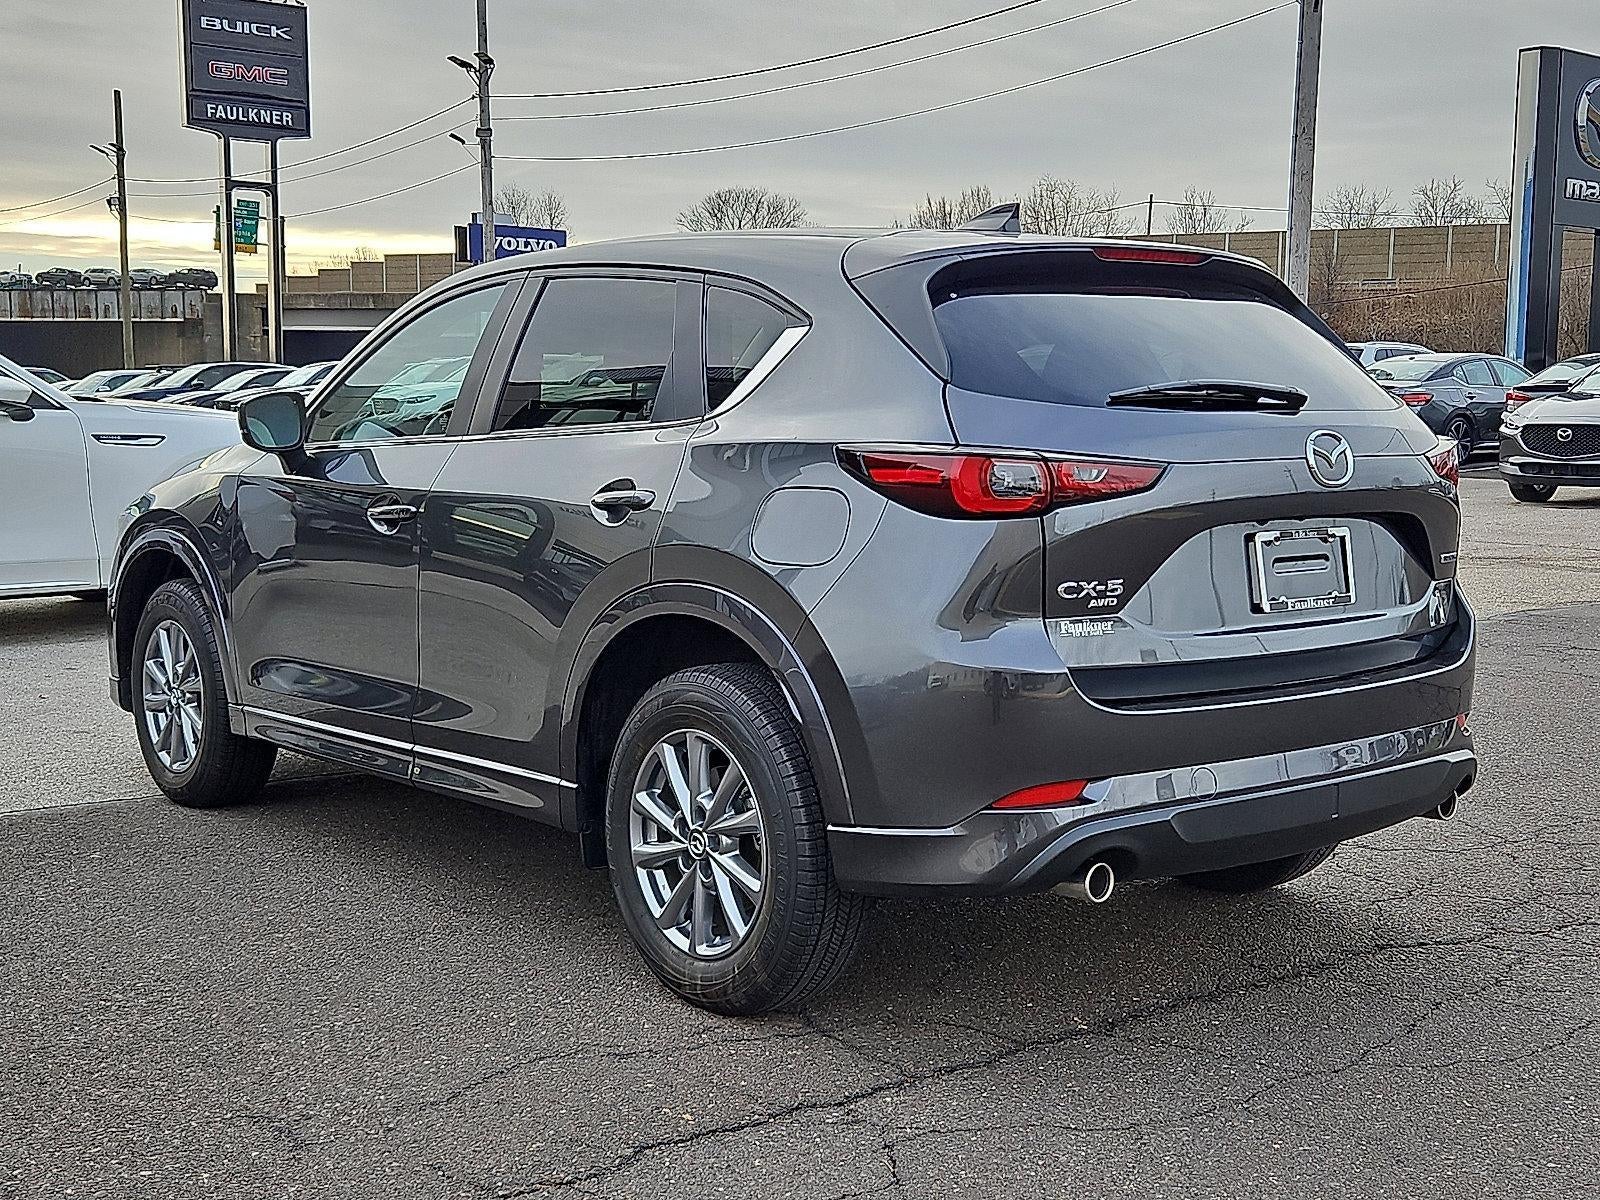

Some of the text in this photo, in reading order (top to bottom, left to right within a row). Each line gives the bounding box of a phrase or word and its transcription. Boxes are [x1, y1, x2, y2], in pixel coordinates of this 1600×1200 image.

[200, 16, 293, 41] BUICK
[208, 60, 288, 86] GMC
[206, 103, 293, 127] FAULKNER
[1057, 578, 1124, 599] CX-5
[1087, 597, 1118, 609] AWD
[1288, 598, 1335, 609] Faulkner
[1059, 620, 1114, 634] Faulkner
